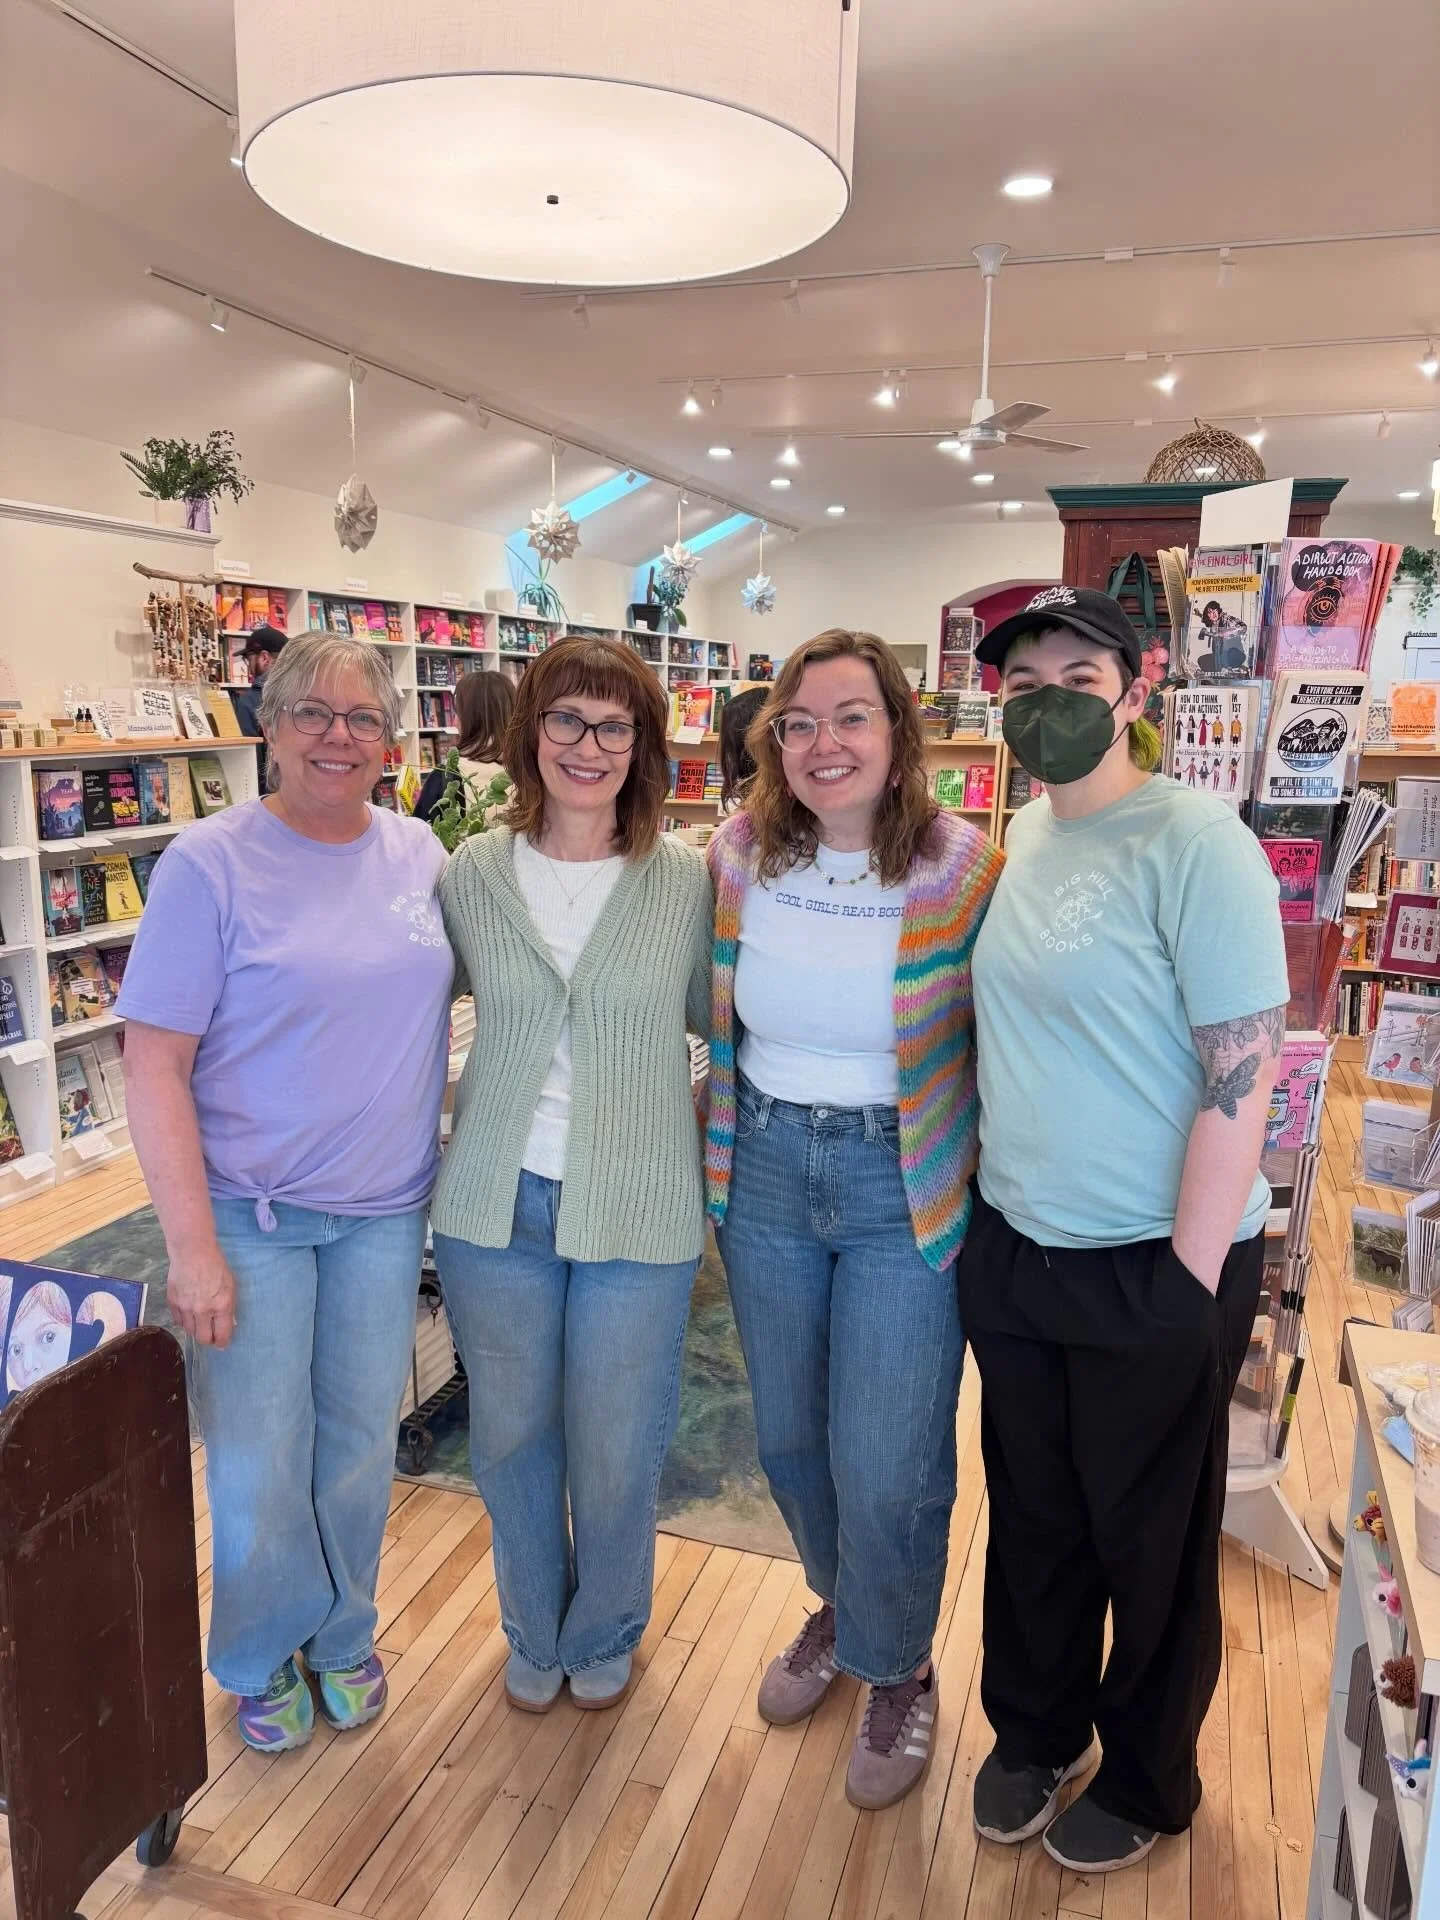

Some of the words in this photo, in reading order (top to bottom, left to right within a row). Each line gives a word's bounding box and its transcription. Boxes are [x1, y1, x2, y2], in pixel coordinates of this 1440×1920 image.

[1208, 555, 1231, 567] FINAL
[1234, 553, 1254, 565] GIRL
[1293, 554, 1301, 565] A
[1302, 552, 1338, 565] DIRECT
[1340, 552, 1373, 565] ACTION
[1303, 565, 1362, 580] HANDBOOK
[1407, 630, 1438, 638] Bathroom
[1306, 686, 1333, 694] EVERYONE
[1335, 686, 1354, 695] CALLS
[1180, 694, 1191, 704] HOW
[1193, 694, 1200, 704] TO
[1202, 694, 1218, 704] THINK
[1296, 695, 1331, 704] THEMSELVES
[1332, 696, 1340, 704] AN
[1342, 696, 1357, 704] ALLY
[1189, 704, 1196, 713] AN
[1198, 704, 1222, 714] ACTIVIST
[972, 767, 989, 775] HOW
[1277, 777, 1293, 786] UNTIL
[1310, 777, 1322, 786] TIME
[678, 785, 702, 793] IDEAS
[938, 783, 964, 796] ACTION
[1280, 788, 1294, 797] SOME
[1296, 788, 1308, 797] REAL
[1308, 788, 1320, 797] ALLY
[1289, 848, 1315, 856] I.W.W.
[1054, 873, 1081, 896] BIG
[1087, 870, 1113, 902] HILL
[776, 893, 802, 908] COOL
[806, 899, 840, 915] GIRLS
[842, 906, 875, 918] READ
[1039, 928, 1094, 953] BOOKS
